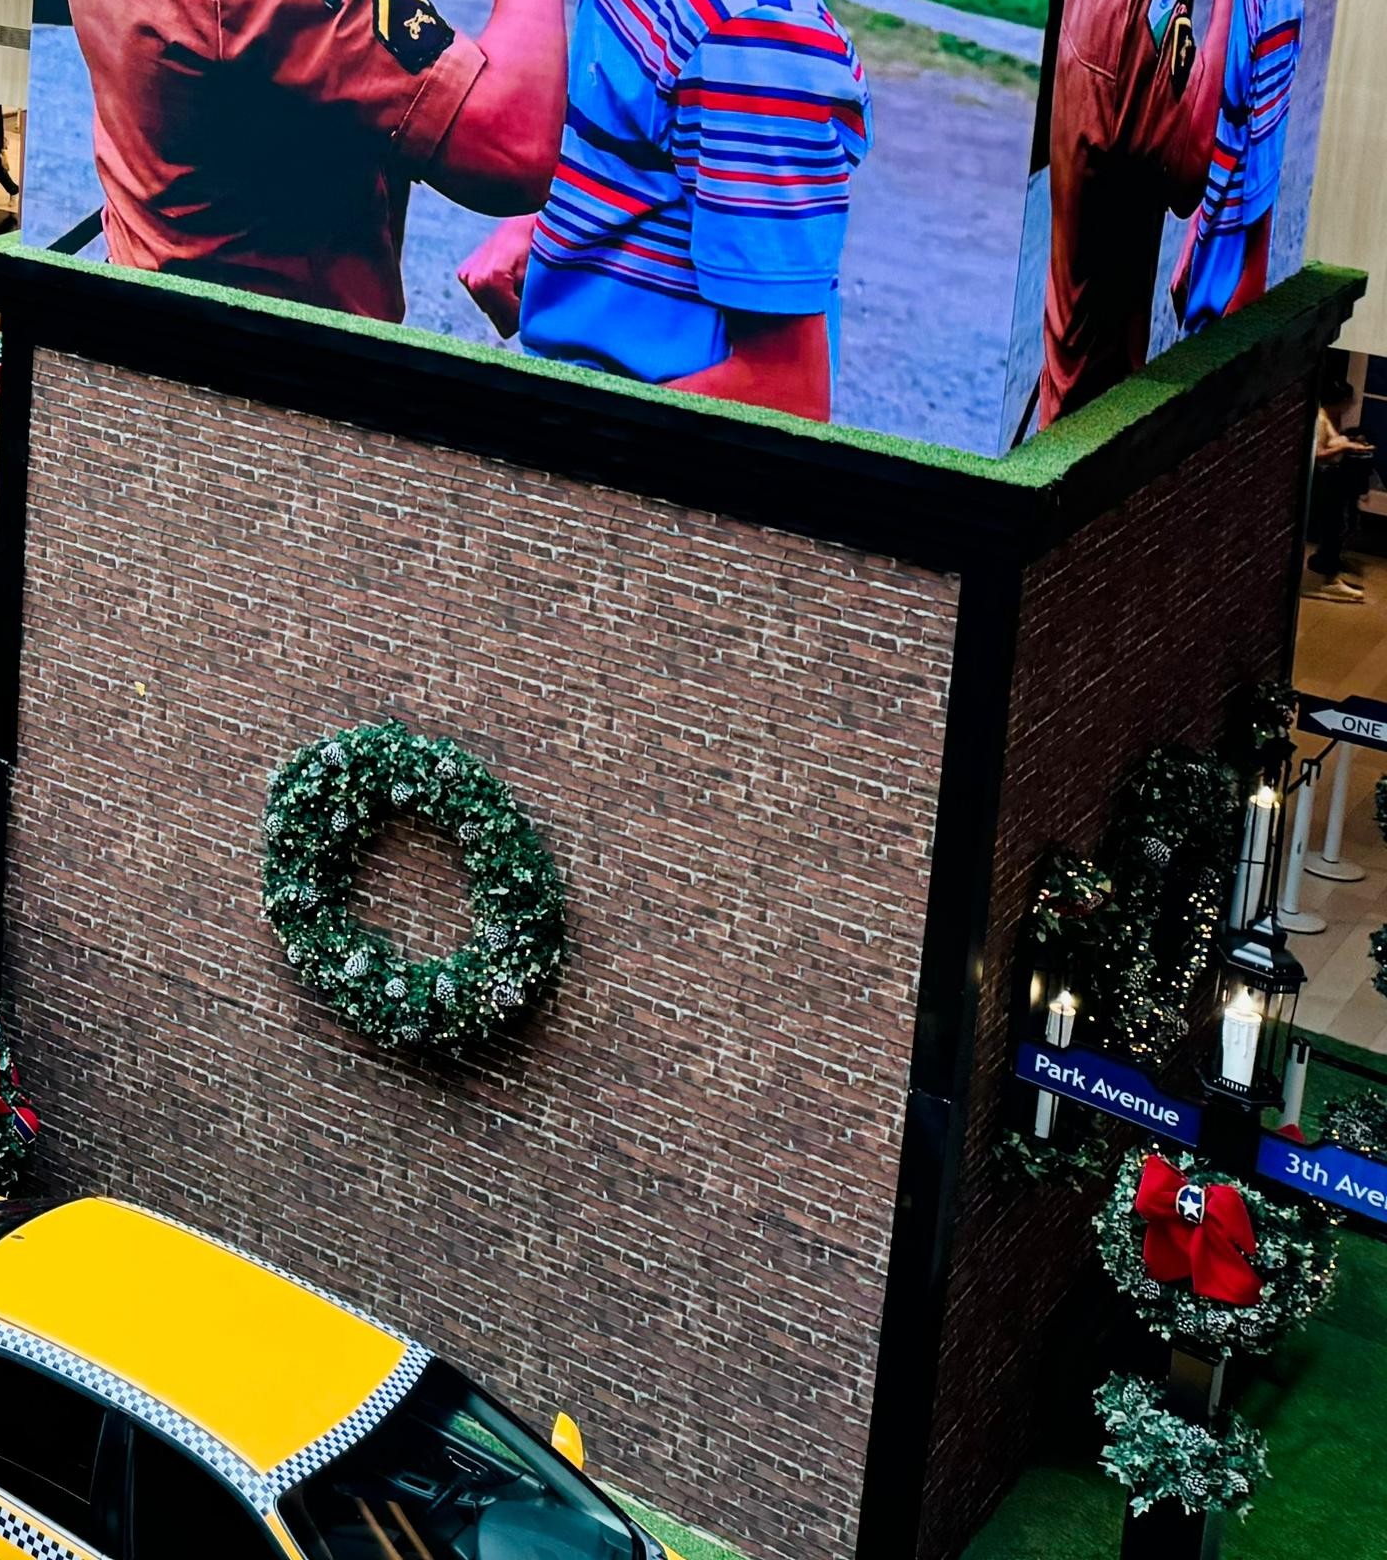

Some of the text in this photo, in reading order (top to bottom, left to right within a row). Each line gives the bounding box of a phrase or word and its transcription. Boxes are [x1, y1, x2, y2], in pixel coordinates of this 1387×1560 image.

[1341, 716, 1383, 738] ONE
[1034, 1053, 1180, 1127] Park Avenue
[1285, 1152, 1329, 1187] 3th
